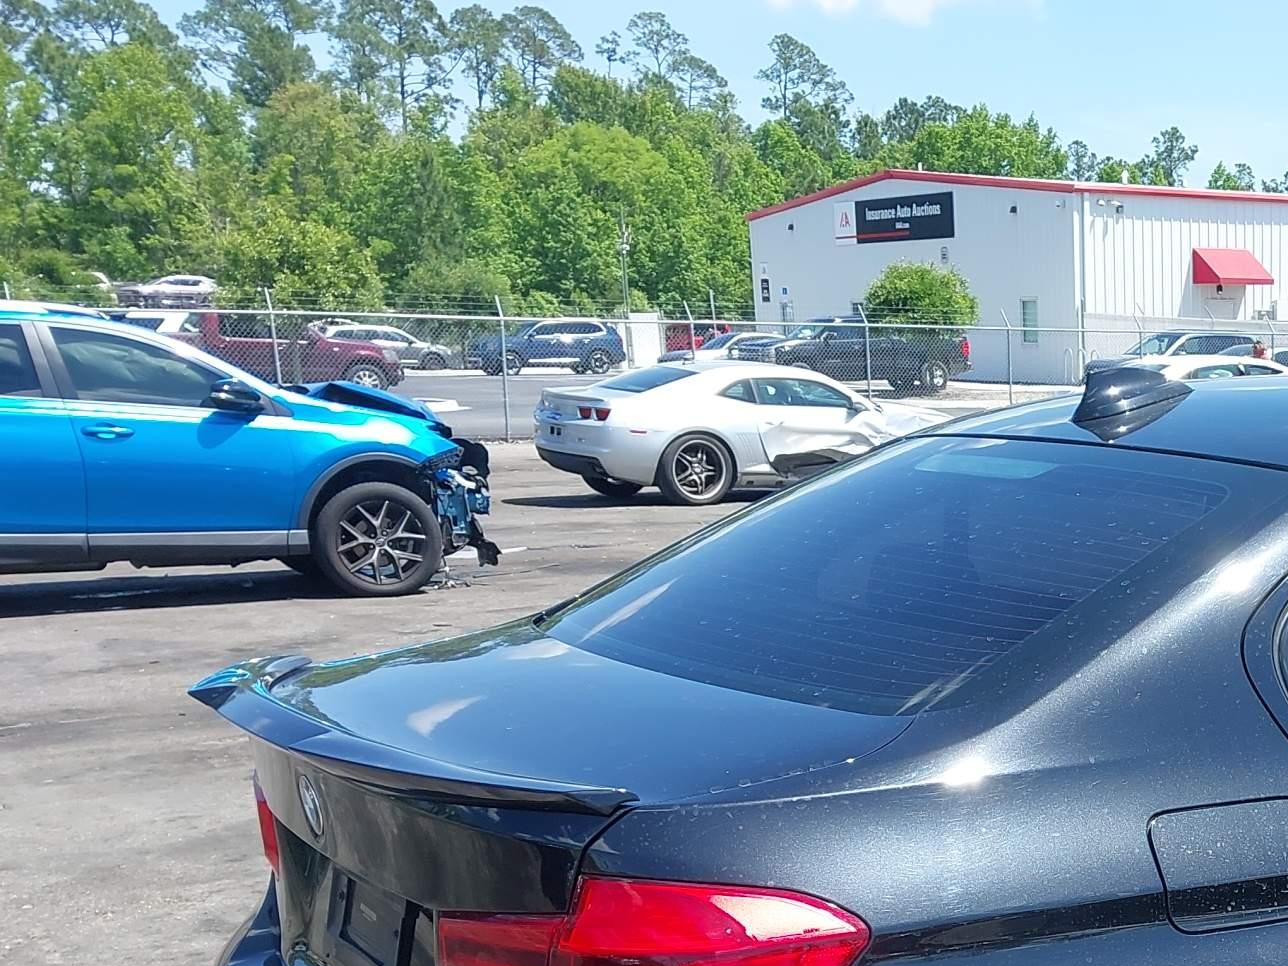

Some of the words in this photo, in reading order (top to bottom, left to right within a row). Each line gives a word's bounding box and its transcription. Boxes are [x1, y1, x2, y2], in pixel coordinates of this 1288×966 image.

[865, 207, 896, 221] Insurance
[896, 204, 911, 219] Auto
[912, 201, 941, 217] Auctions
